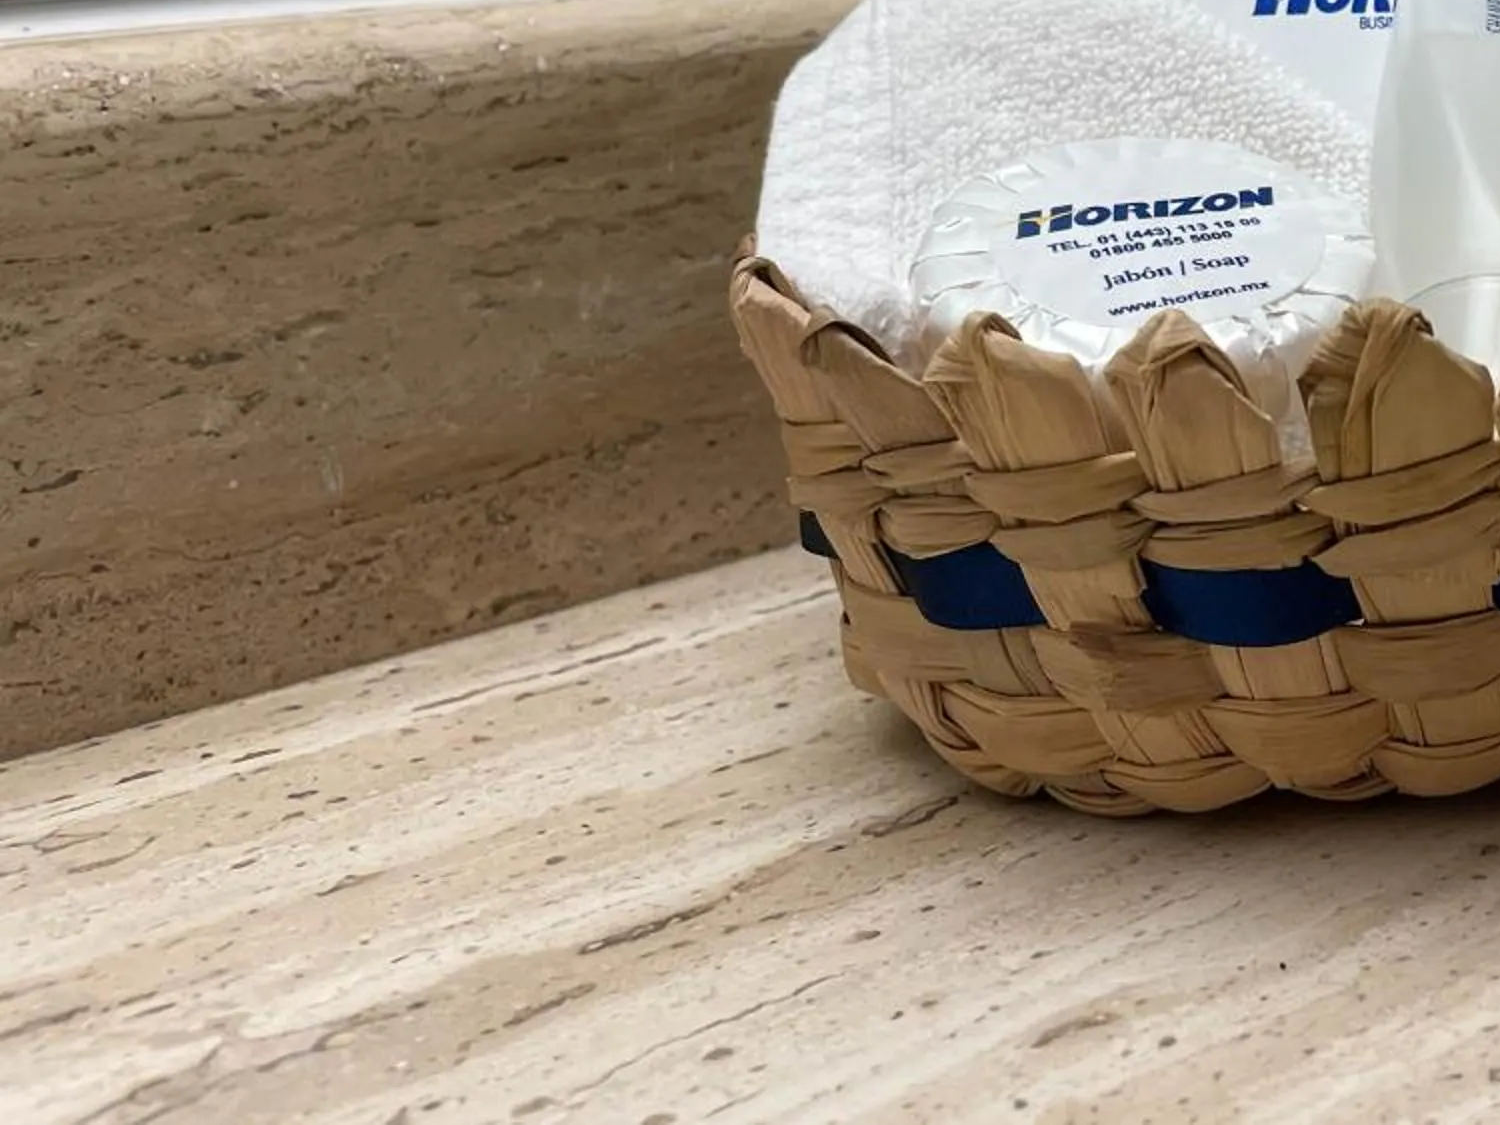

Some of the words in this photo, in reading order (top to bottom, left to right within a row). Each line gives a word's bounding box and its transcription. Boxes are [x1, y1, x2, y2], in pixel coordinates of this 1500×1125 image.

[1015, 186, 1274, 240] HORIZON
[1047, 239, 1092, 254] TEL.
[1097, 233, 1118, 246] 01
[1126, 226, 1171, 243] (443)
[1176, 221, 1207, 235] 113
[1089, 240, 1146, 259] 01800
[1190, 229, 1233, 245] 5000
[1103, 265, 1173, 291] Jabón
[1192, 252, 1250, 273] Soap
[1108, 280, 1271, 317] www.horizon.mx
